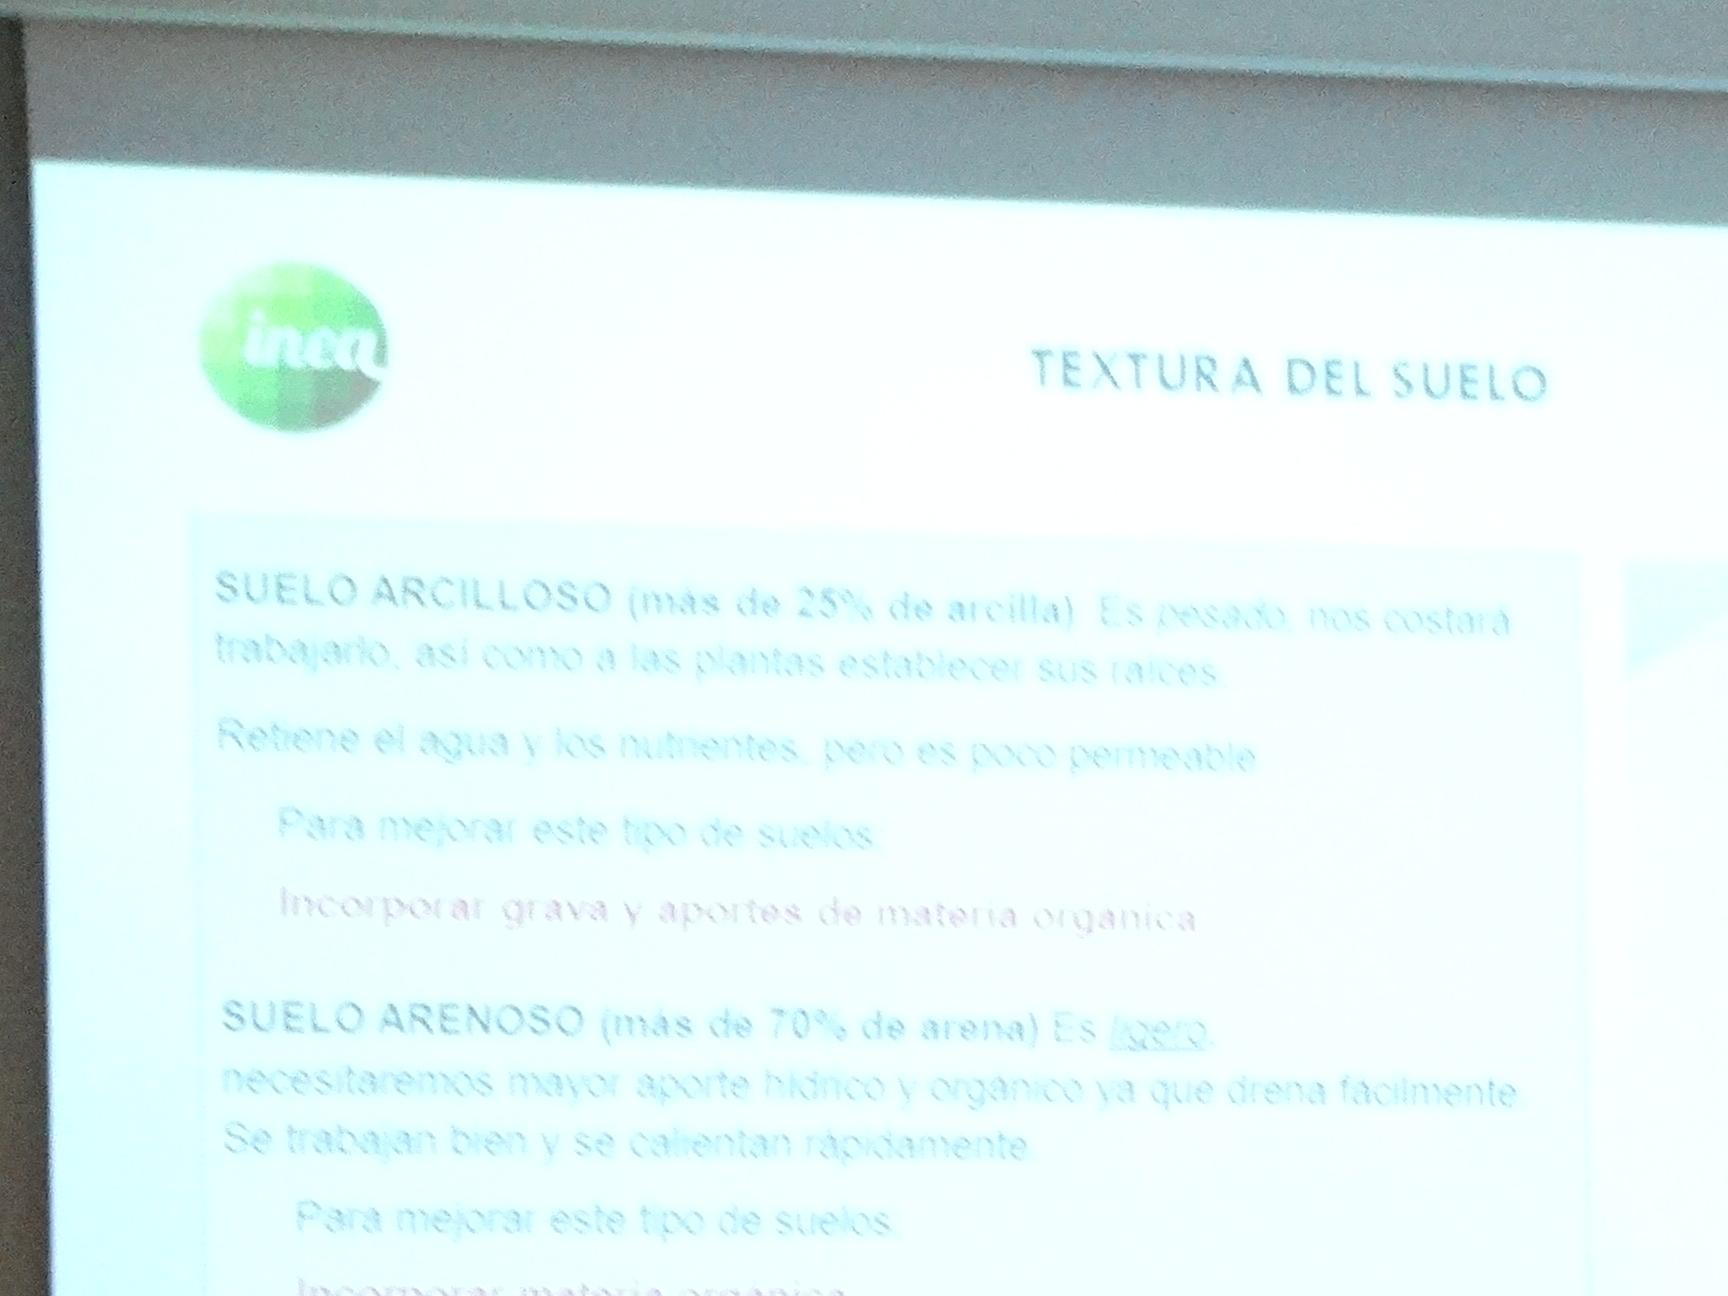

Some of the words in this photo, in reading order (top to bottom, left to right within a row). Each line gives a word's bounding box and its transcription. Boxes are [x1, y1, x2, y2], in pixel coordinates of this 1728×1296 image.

[1029, 345, 1264, 396] TEXTURA
[1284, 354, 1373, 401] DEL
[1390, 358, 1550, 405] SUELO
[214, 568, 359, 607] SUELO
[370, 573, 613, 614] ARCILLOSO
[735, 586, 782, 618] de
[797, 584, 874, 623] 25%
[887, 591, 934, 623] de
[1096, 591, 1146, 630] Es
[1307, 605, 1372, 634] nos
[481, 643, 585, 673] como
[594, 646, 617, 673] a
[629, 643, 682, 675] las
[694, 644, 826, 682] plantas
[836, 648, 1022, 684] establecer
[1036, 656, 1099, 687] sus
[216, 715, 361, 754] Retiene
[372, 723, 406, 756] el
[419, 729, 510, 766] agua
[522, 733, 541, 766] y
[553, 726, 608, 760] los
[822, 737, 906, 771] pero
[915, 740, 958, 767] es
[967, 741, 1059, 774] poco
[277, 804, 367, 842] Para
[378, 815, 516, 849] mejorar
[530, 815, 609, 846] este
[621, 815, 689, 854] tipo
[699, 816, 746, 849] de
[818, 895, 862, 927] de
[877, 901, 1018, 929] materia
[221, 998, 367, 1035] SUELO
[378, 1001, 586, 1039] ARENOSO
[707, 1007, 754, 1040] de
[769, 1005, 849, 1043] 70%
[860, 1009, 907, 1042] de
[919, 1012, 1040, 1048] arena)
[1052, 1009, 1097, 1045] Es
[222, 1064, 495, 1098] necesitaremos
[508, 1071, 621, 1105] mayor
[635, 1069, 752, 1106] aporte
[897, 1076, 919, 1109] y
[1095, 1078, 1137, 1110] ya
[1148, 1078, 1216, 1112] que
[1225, 1074, 1329, 1106] drena
[224, 1120, 274, 1156] Se
[285, 1123, 437, 1161] trabajan
[449, 1124, 529, 1158] bien
[540, 1132, 561, 1165] y
[574, 1130, 616, 1159] se
[628, 1126, 793, 1160] calientan
[295, 1199, 383, 1234] Para
[395, 1207, 535, 1242] mejorar
[548, 1203, 627, 1236] este
[638, 1204, 706, 1243] tipo
[717, 1205, 763, 1237] de
